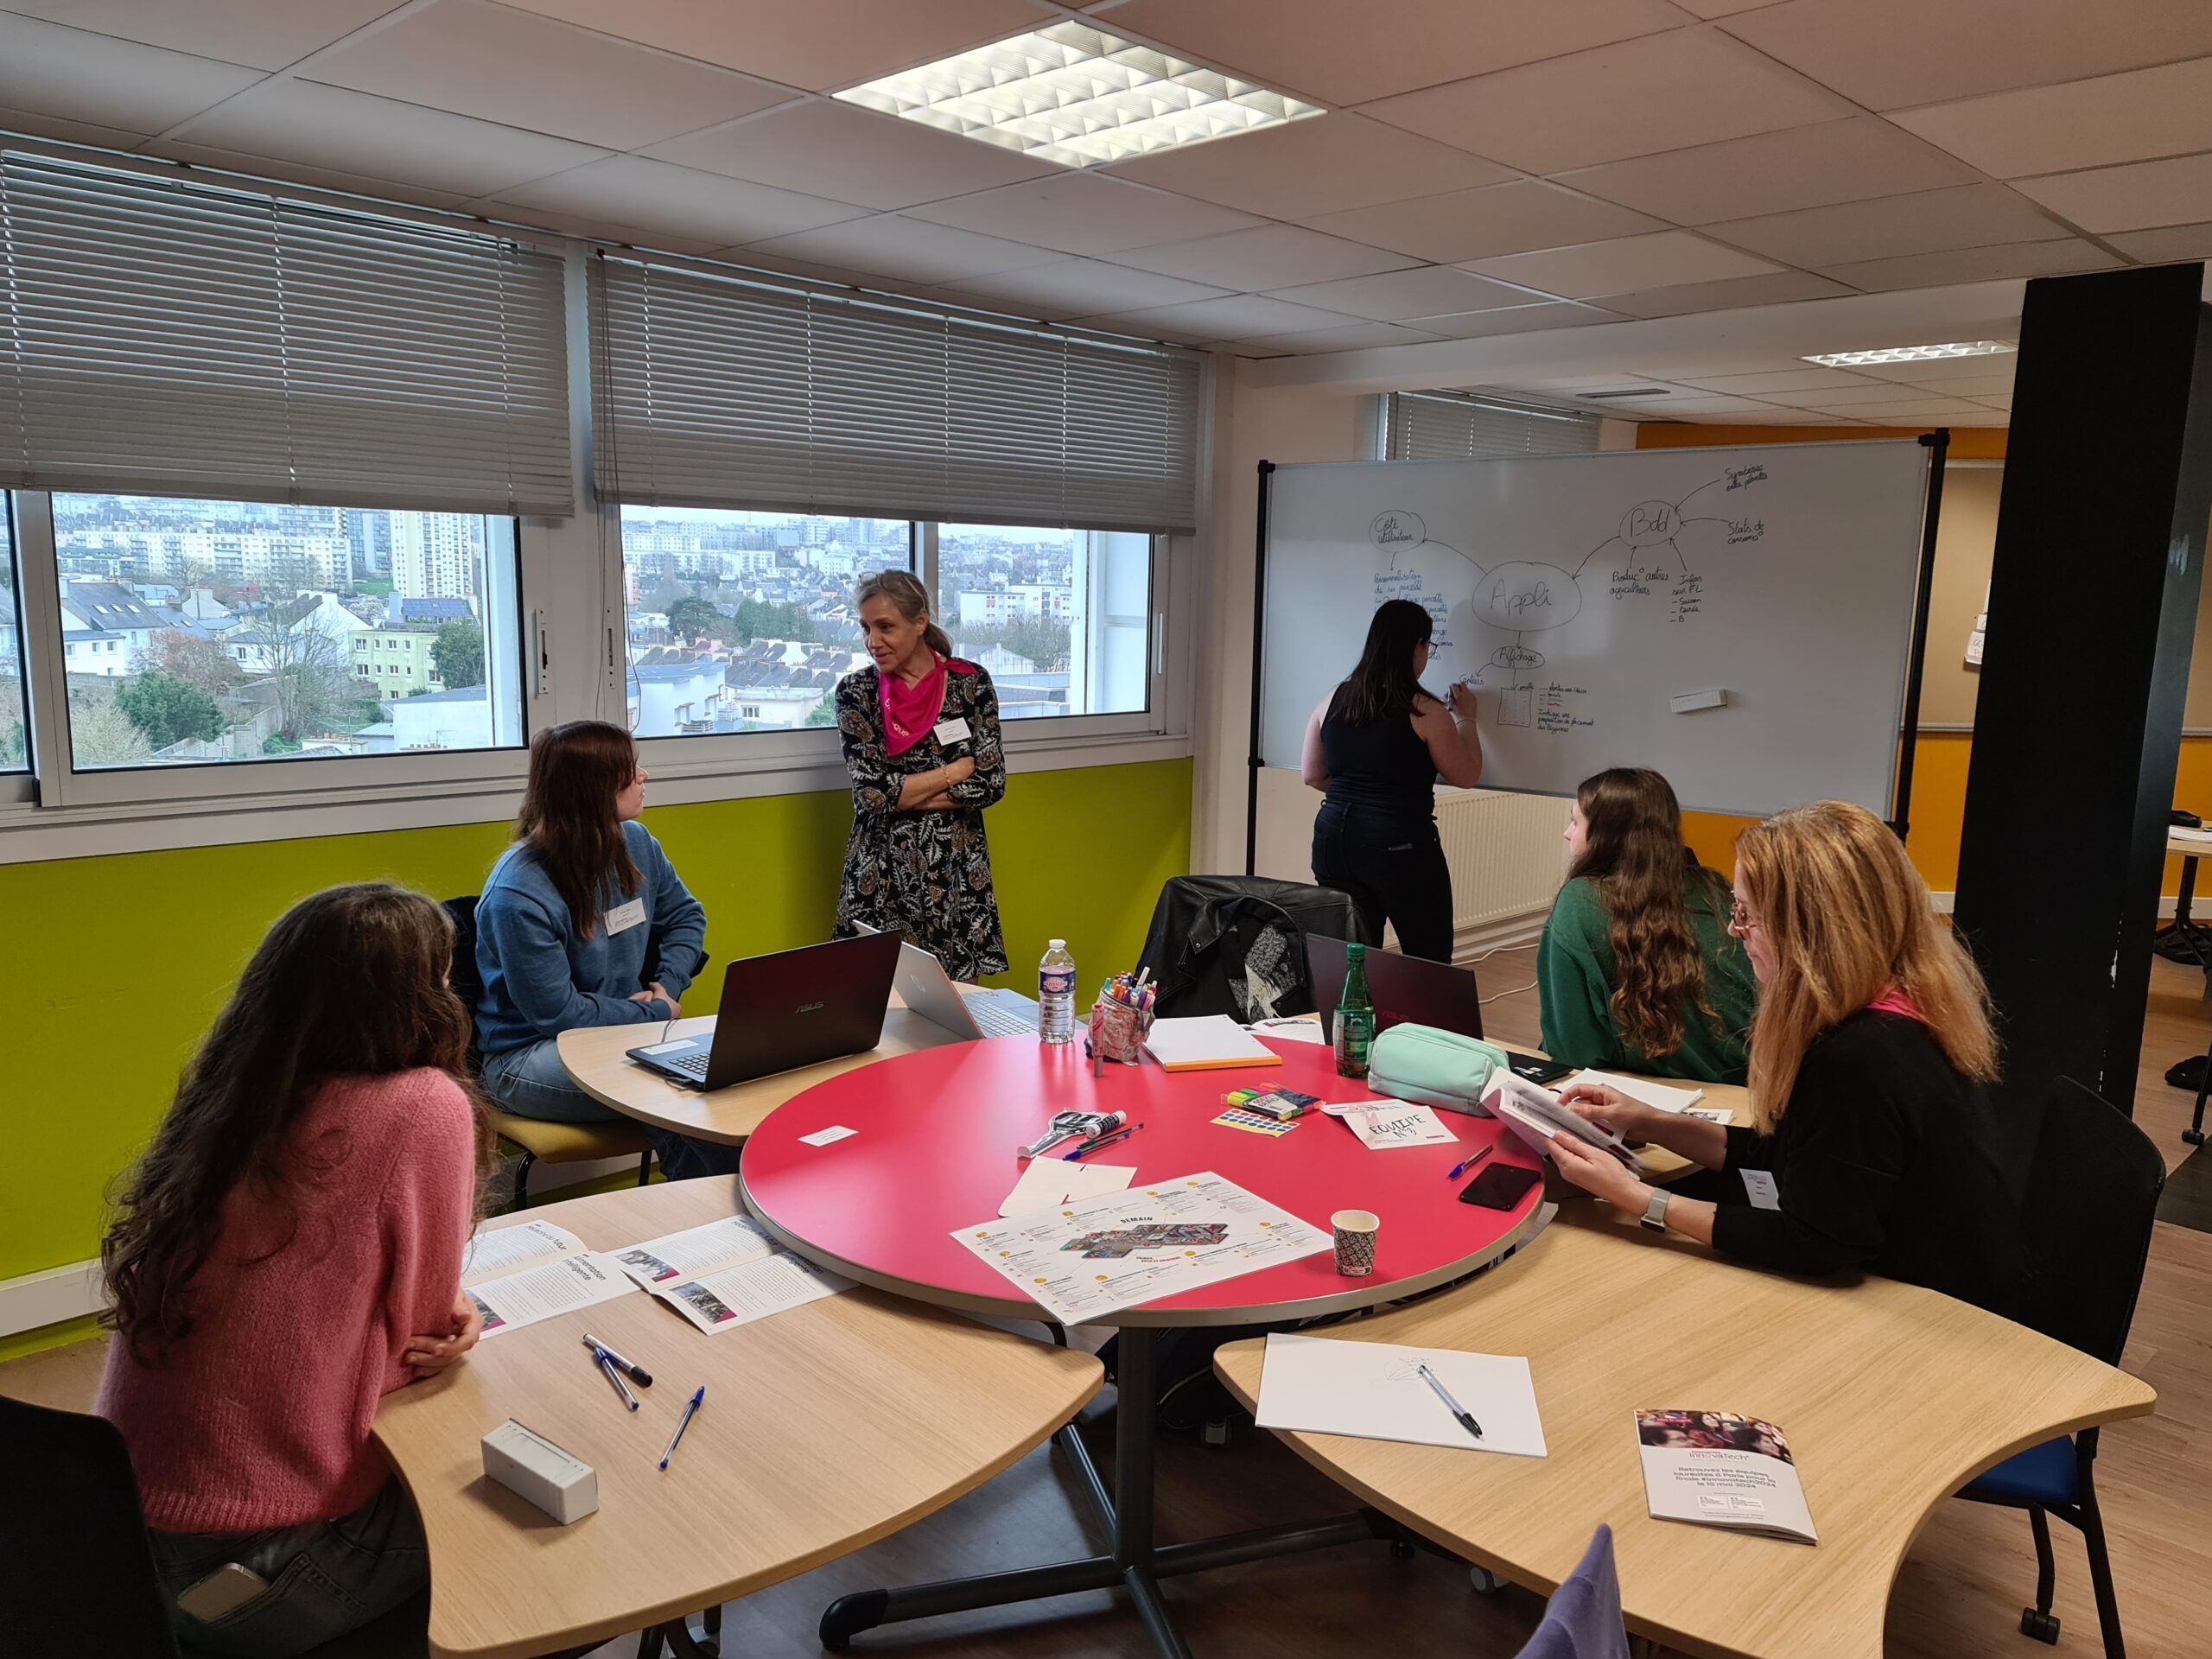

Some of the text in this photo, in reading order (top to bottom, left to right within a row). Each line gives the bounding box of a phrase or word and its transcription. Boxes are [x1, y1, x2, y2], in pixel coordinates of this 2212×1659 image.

[1630, 508, 1670, 537] Bdd
[1728, 518, 1764, 536] Stats de
[1491, 578, 1553, 615] Appli
[1499, 648, 1537, 669] Affichage
[795, 1001, 825, 1014] ASUS
[553, 1238, 567, 1250] futur
[1735, 1469, 1770, 1478] équipes
[1701, 1477, 1777, 1488] #innovatech2024
